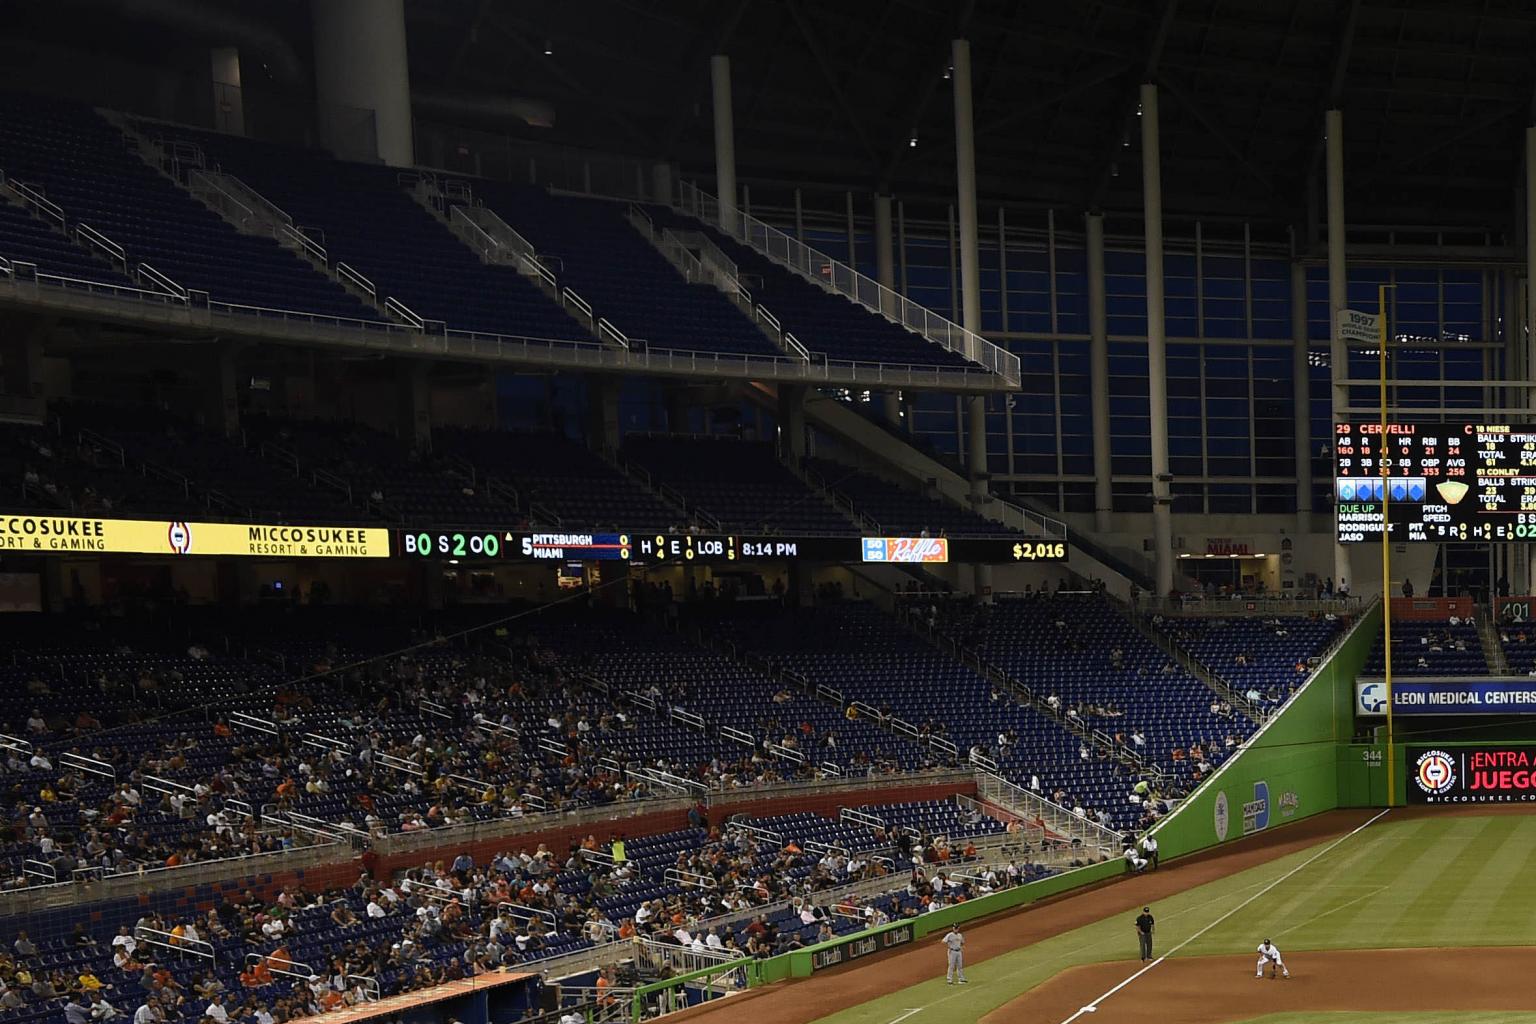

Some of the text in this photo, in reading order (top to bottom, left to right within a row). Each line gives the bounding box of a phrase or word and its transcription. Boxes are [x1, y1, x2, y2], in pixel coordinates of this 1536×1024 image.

[1349, 313, 1375, 326] 1997
[1336, 425, 1473, 434] 29 C
[1338, 437, 1460, 446] AB HR RBI BB
[1477, 434, 1504, 443] BALLS
[1478, 451, 1506, 459] TOTAL
[1421, 459, 1465, 467] OBP AVG
[1487, 468, 1520, 476] CONLEY
[1478, 477, 1505, 486] BALLS
[1478, 494, 1506, 503] TOTAL
[1340, 504, 1375, 513] DUE UP
[1422, 504, 1448, 513] PITCH
[1422, 513, 1451, 522] SPEED
[1409, 523, 1424, 531] PIT
[1449, 526, 1505, 537] R H E
[249, 527, 367, 544] MICCOSUKEE
[532, 534, 593, 546] PITTSBURGH
[1339, 533, 1364, 541] JASO
[1409, 532, 1427, 540] MIA
[33, 537, 105, 549] & GAMING
[522, 537, 532, 555] 5
[641, 540, 723, 555] H E LOB
[250, 543, 368, 555] RESORT & GAMING
[533, 548, 563, 559] MIAMI
[743, 542, 797, 556] 8:14 PM
[1013, 543, 1065, 560] $2,016
[1395, 691, 1426, 705] LEON
[1431, 691, 1482, 704] MEDICAL
[1363, 750, 1381, 761] 344
[1416, 750, 1456, 766] MICCOSUKEE
[1471, 752, 1528, 771] ¡ENTRA
